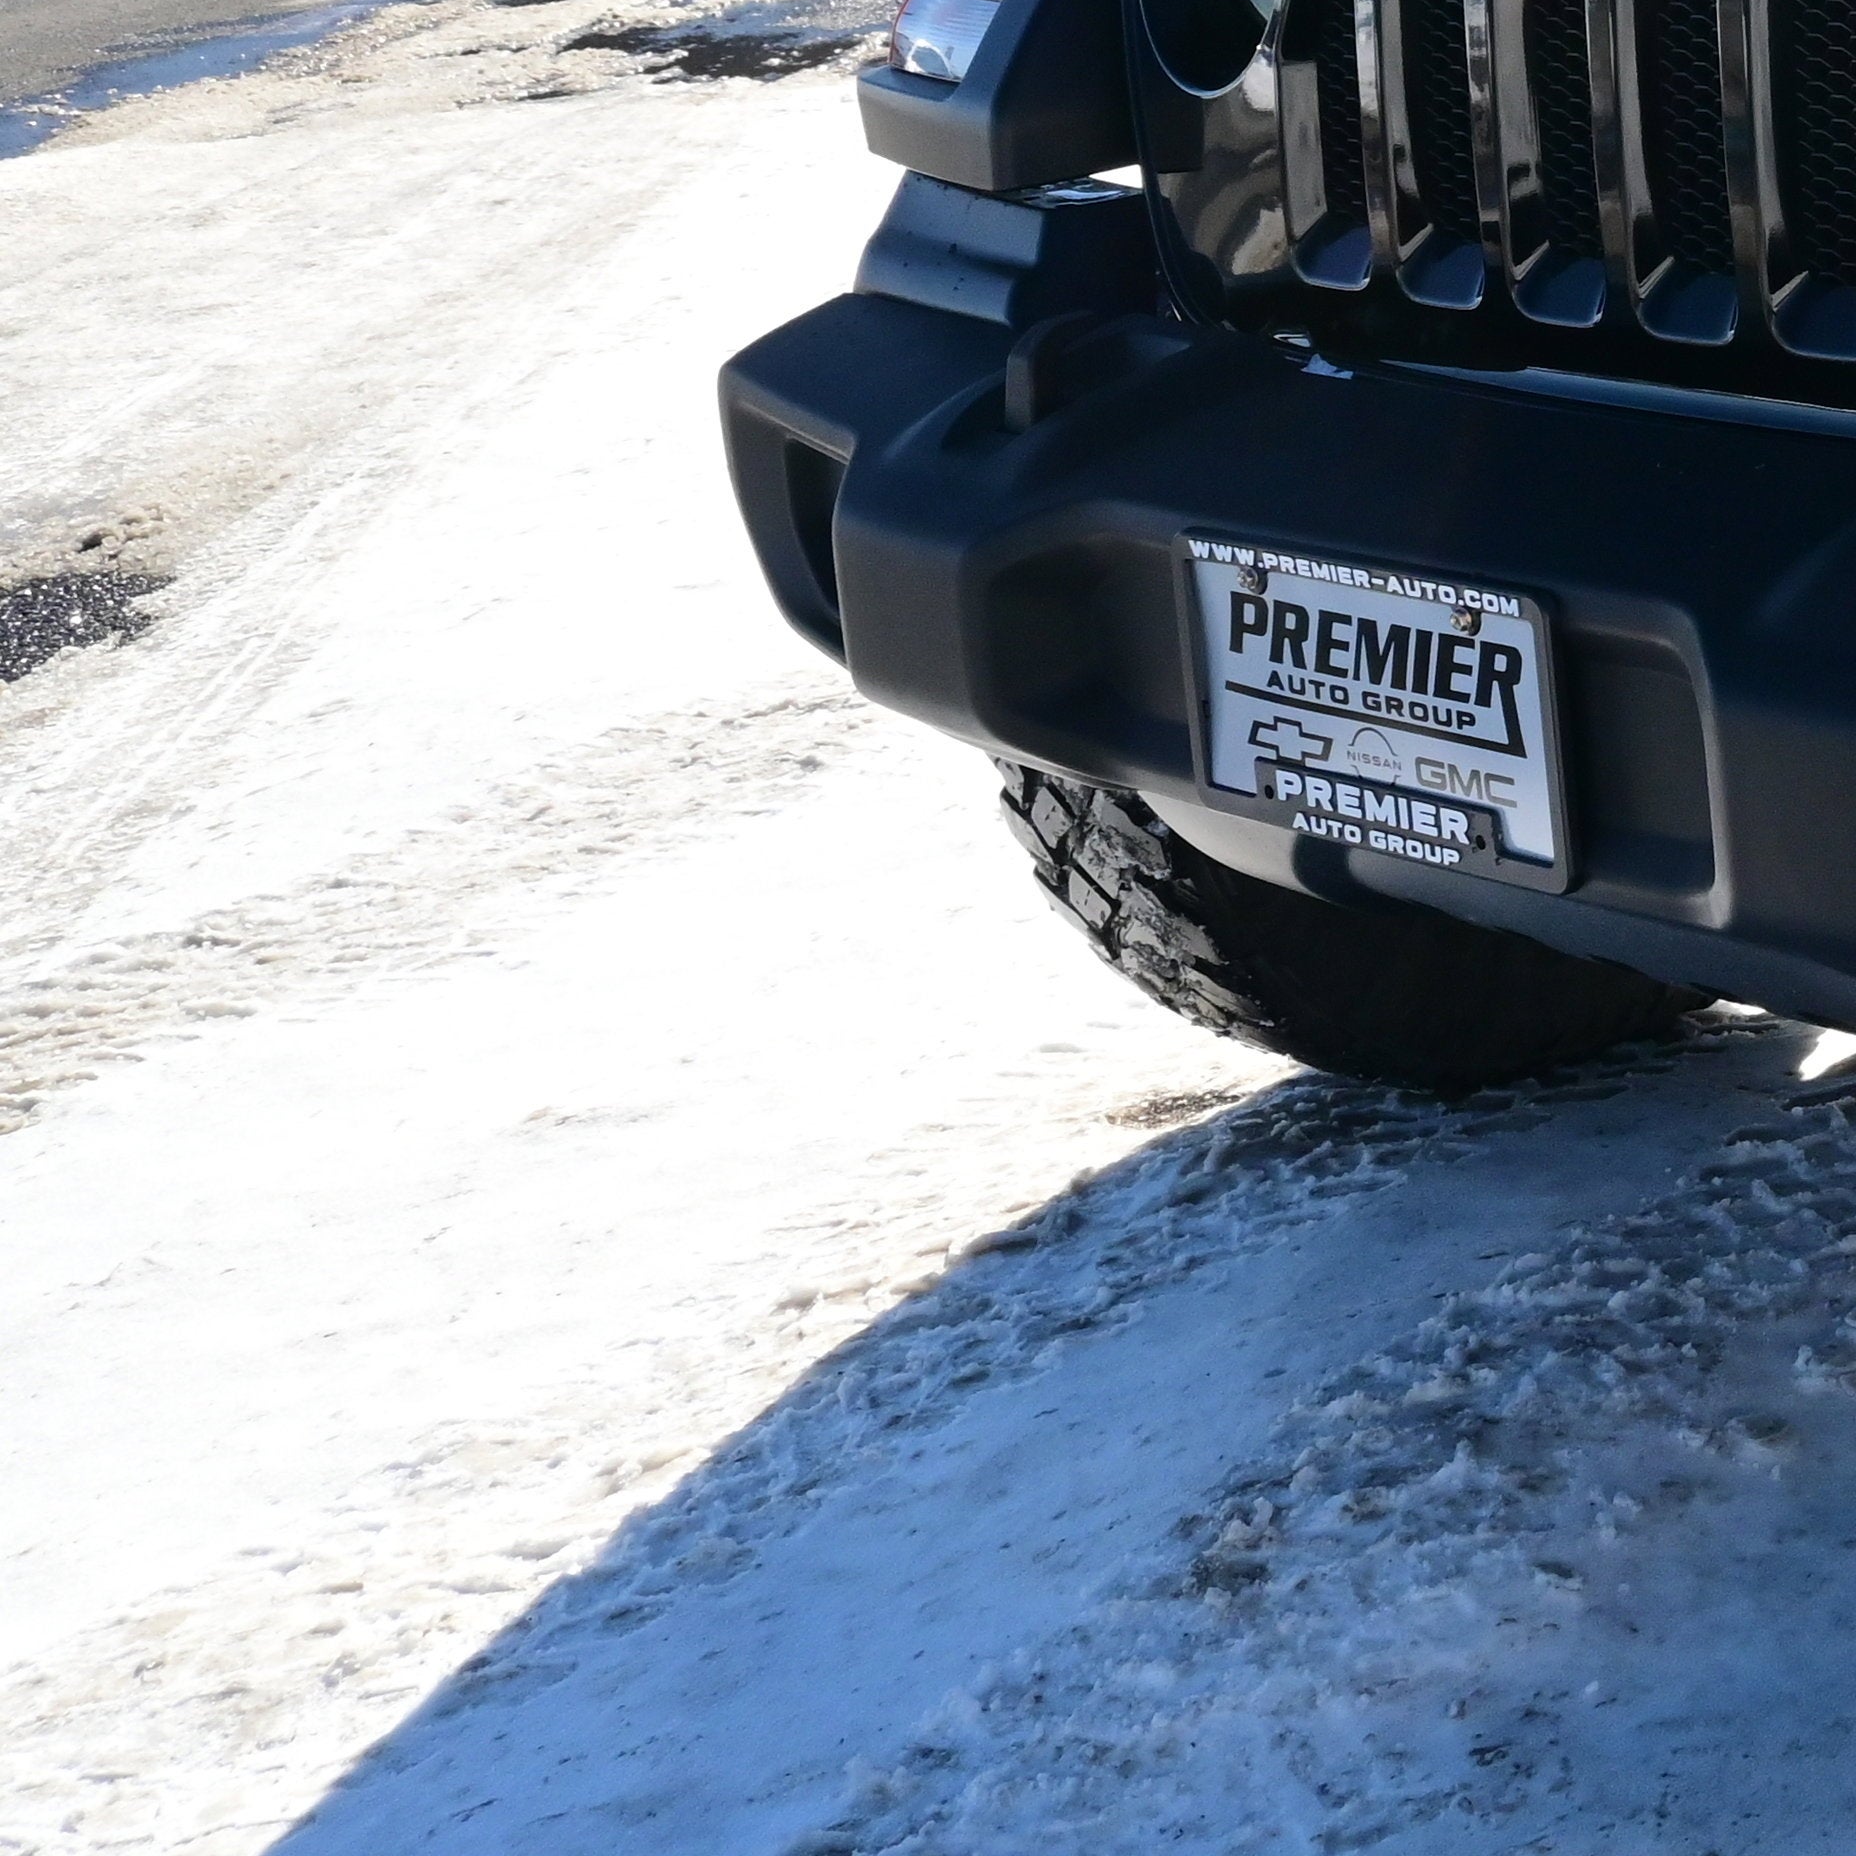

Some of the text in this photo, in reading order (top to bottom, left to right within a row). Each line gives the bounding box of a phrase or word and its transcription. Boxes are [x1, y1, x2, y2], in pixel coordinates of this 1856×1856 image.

[1188, 538, 1521, 618] WWW.PREMIER-AUTO.COM
[1228, 590, 1525, 719] PREMIER
[1266, 670, 1477, 731] AUTO GROUP
[1346, 749, 1403, 771] NISSAN
[1414, 756, 1518, 808] GMC
[1275, 770, 1470, 846] PREMIER
[1292, 812, 1461, 866] AUTO GROUP
